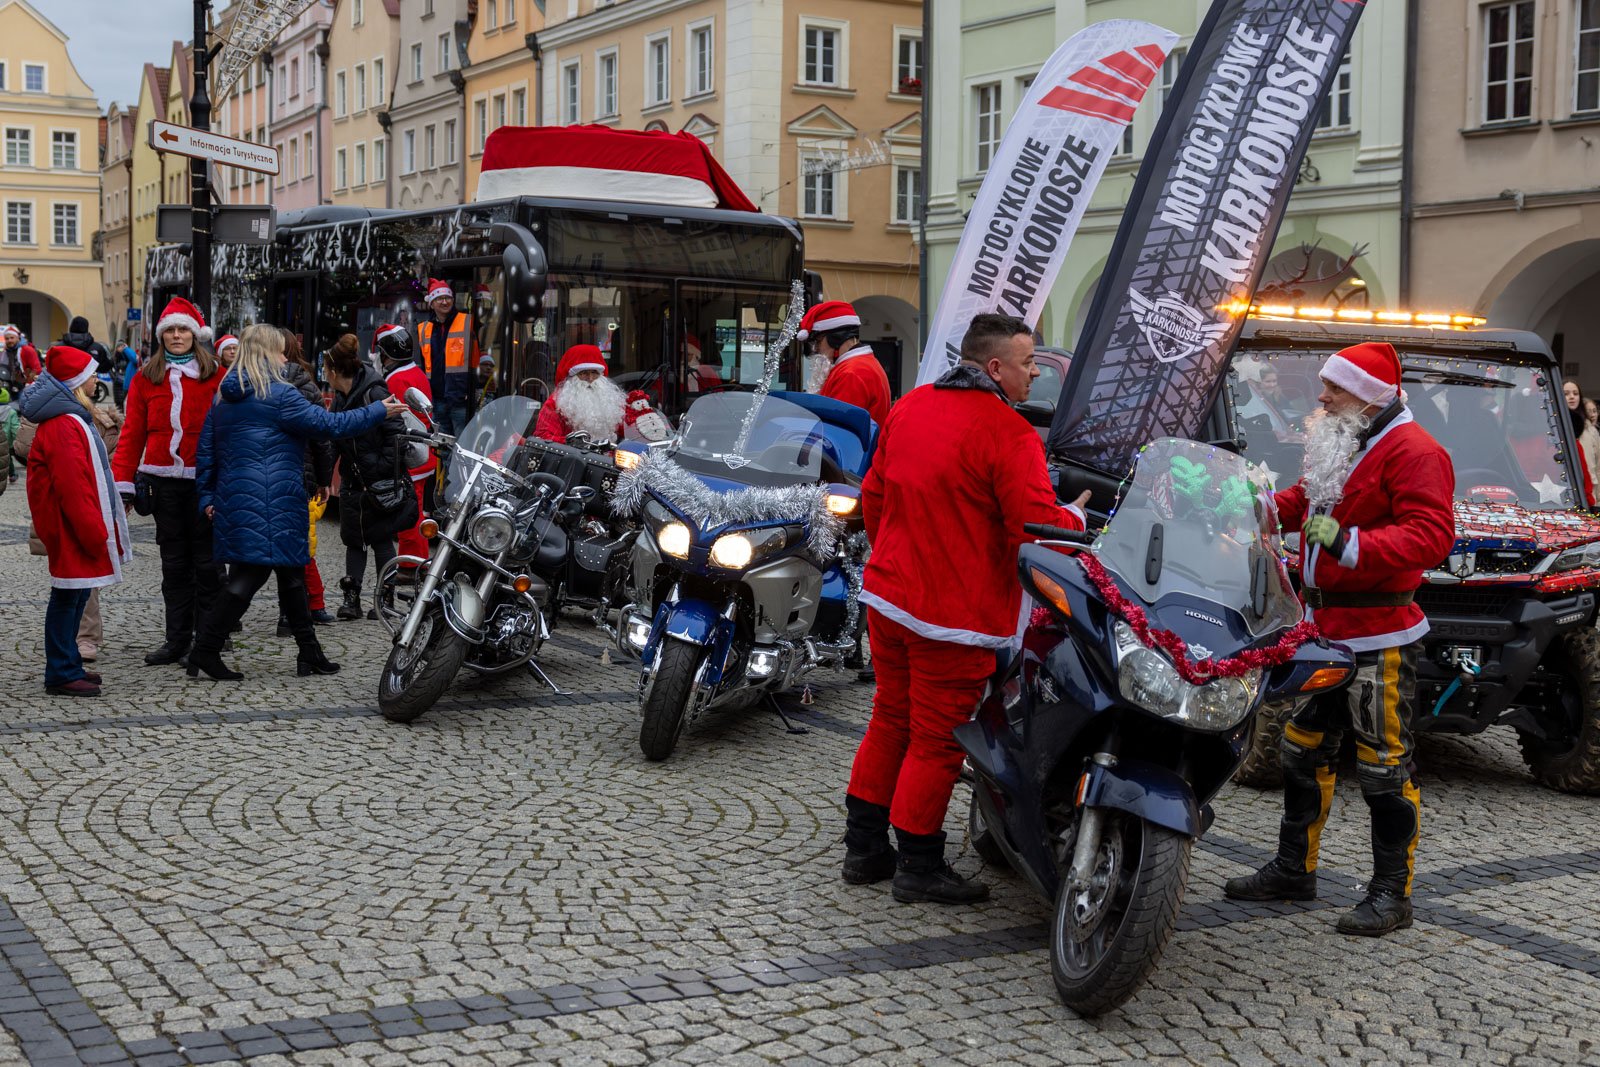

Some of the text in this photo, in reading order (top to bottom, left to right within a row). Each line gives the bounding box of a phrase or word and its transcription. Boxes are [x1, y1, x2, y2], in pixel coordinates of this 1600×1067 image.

[1160, 22, 1269, 232] MOTOCYKLOWE
[189, 136, 273, 164] Informacja Turystyczna
[1200, 16, 1335, 282] KARKONOSZE
[967, 137, 1050, 298] MOTOCYKLOWE
[1145, 311, 1202, 343] KARKONOSZE
[1160, 306, 1195, 328] MOTOCYKLOWE
[1185, 610, 1223, 627] HONDA
